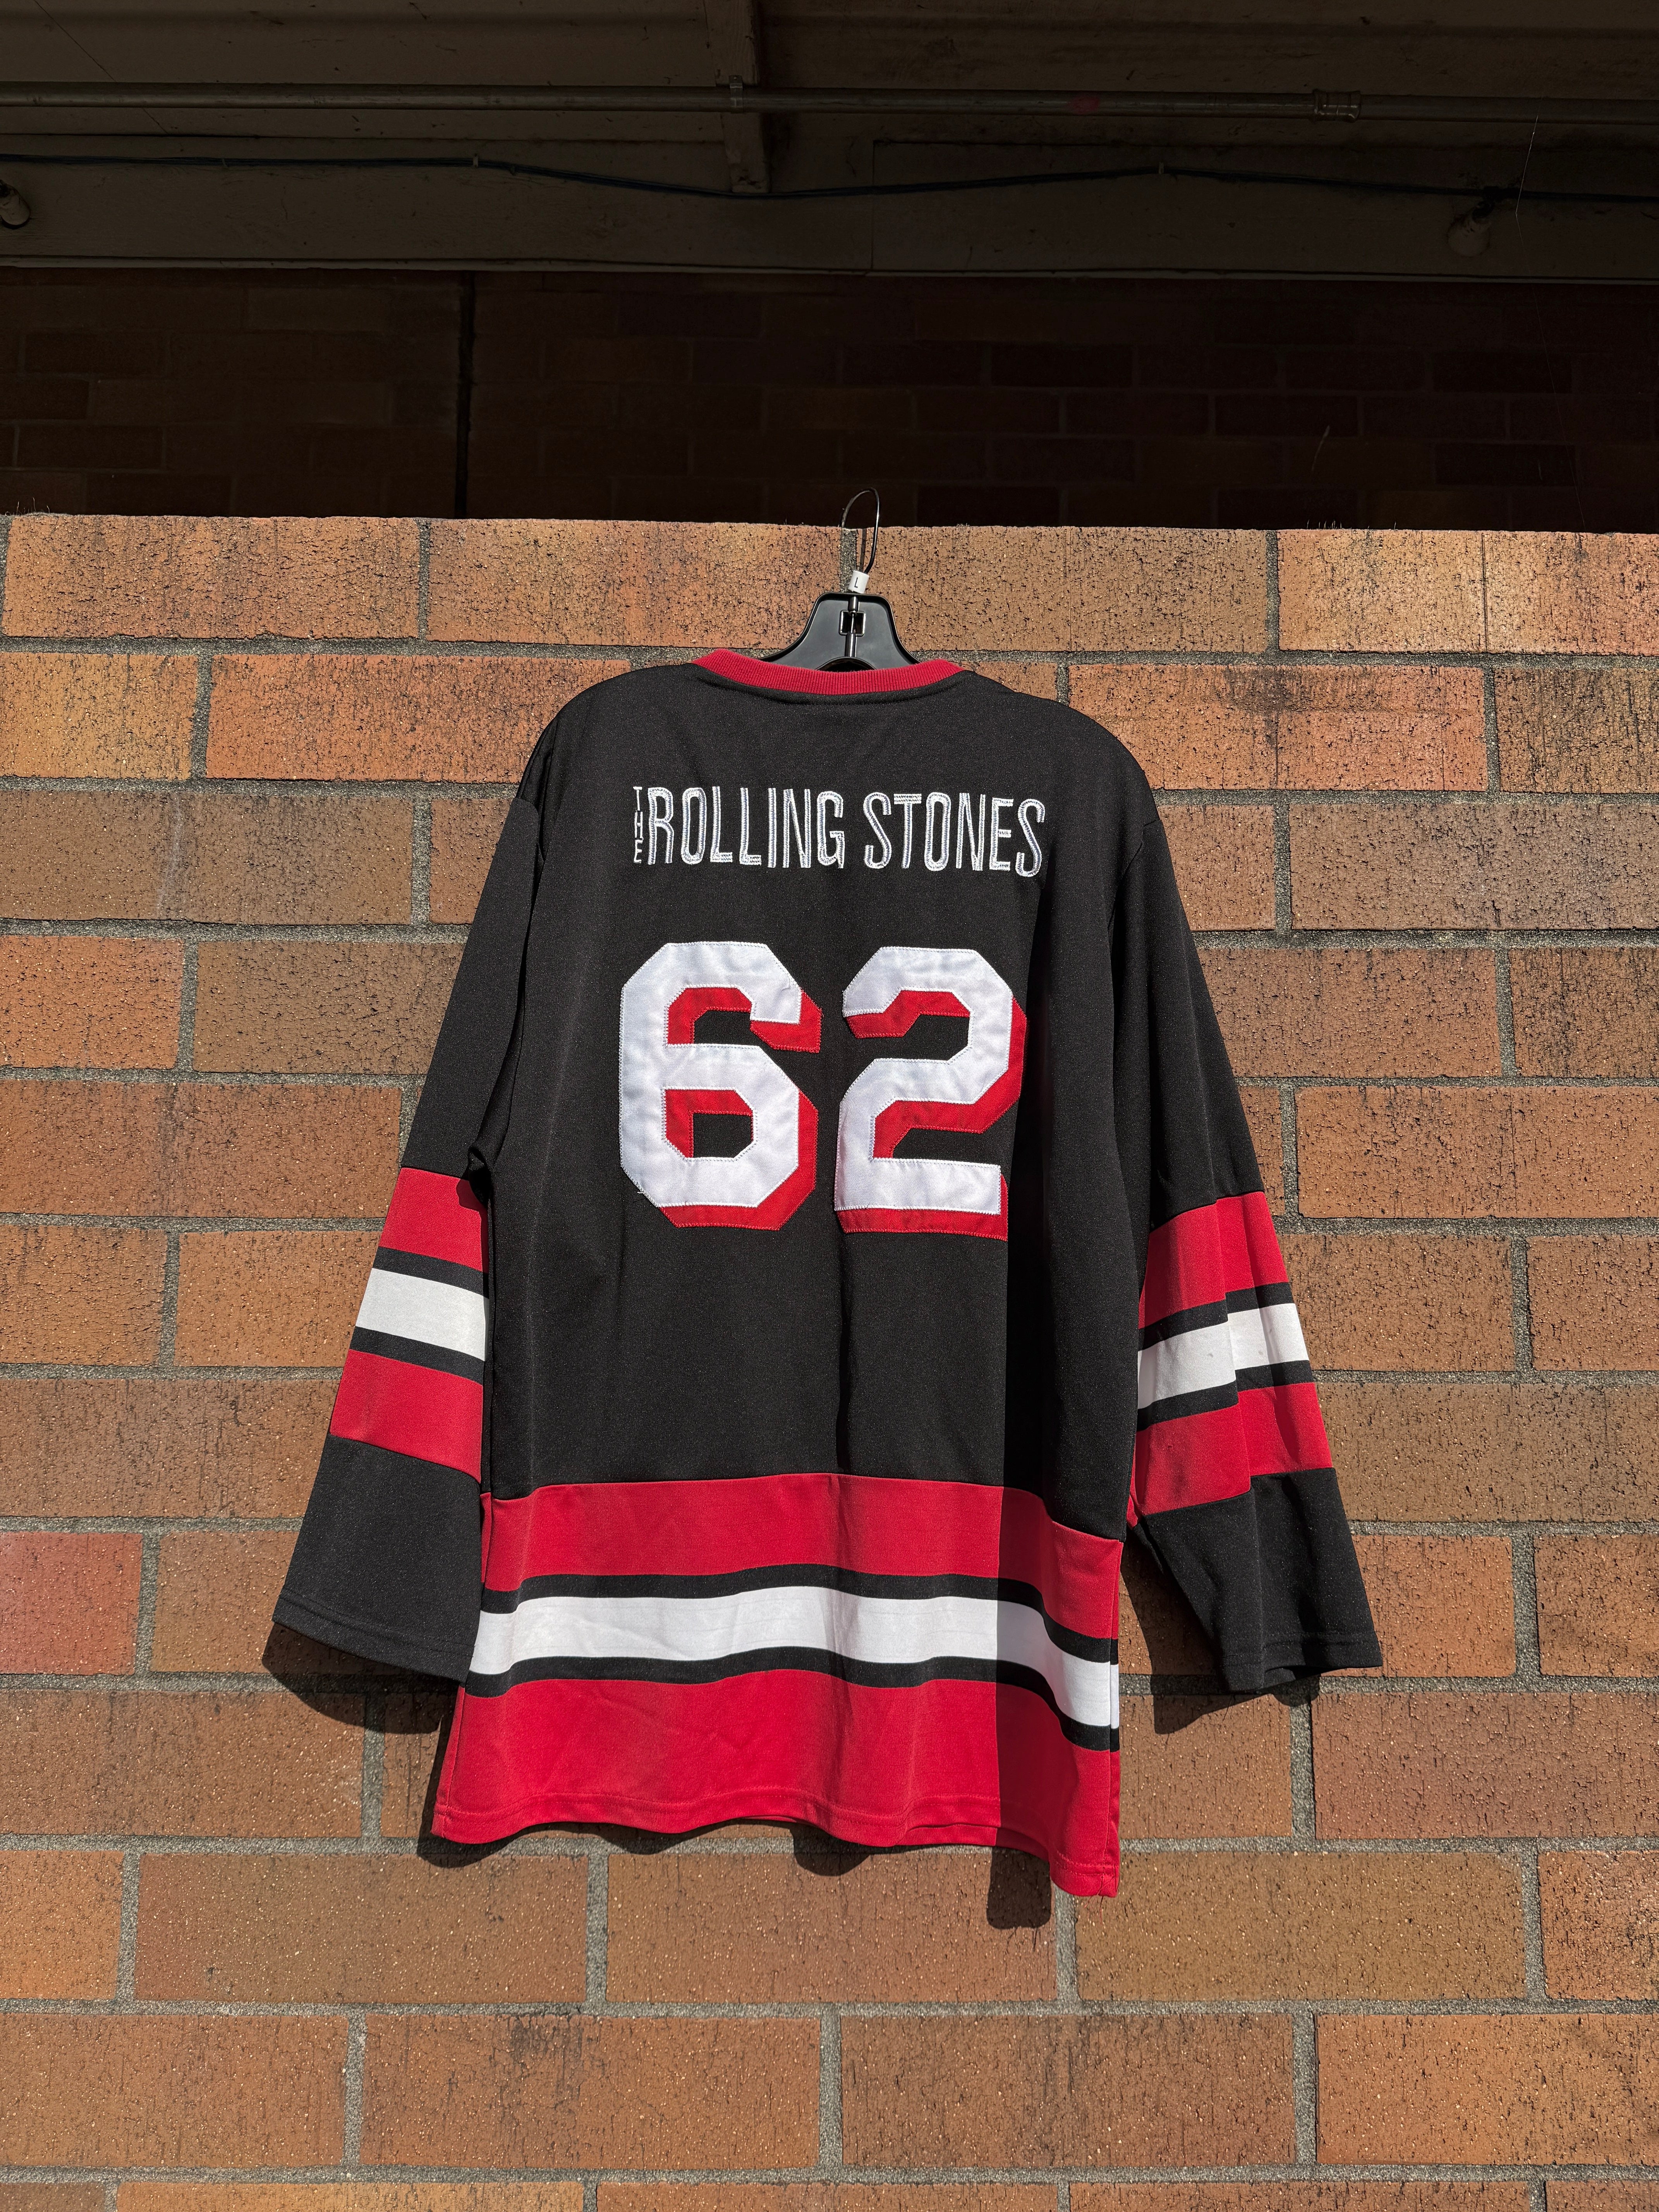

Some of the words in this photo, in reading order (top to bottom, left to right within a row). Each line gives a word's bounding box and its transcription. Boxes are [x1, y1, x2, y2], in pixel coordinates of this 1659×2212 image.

[854, 577, 858, 588] L
[633, 786, 643, 864] THE
[647, 787, 845, 869] ROLLING
[863, 792, 1045, 878] STONES
[619, 941, 1027, 1241] 62
